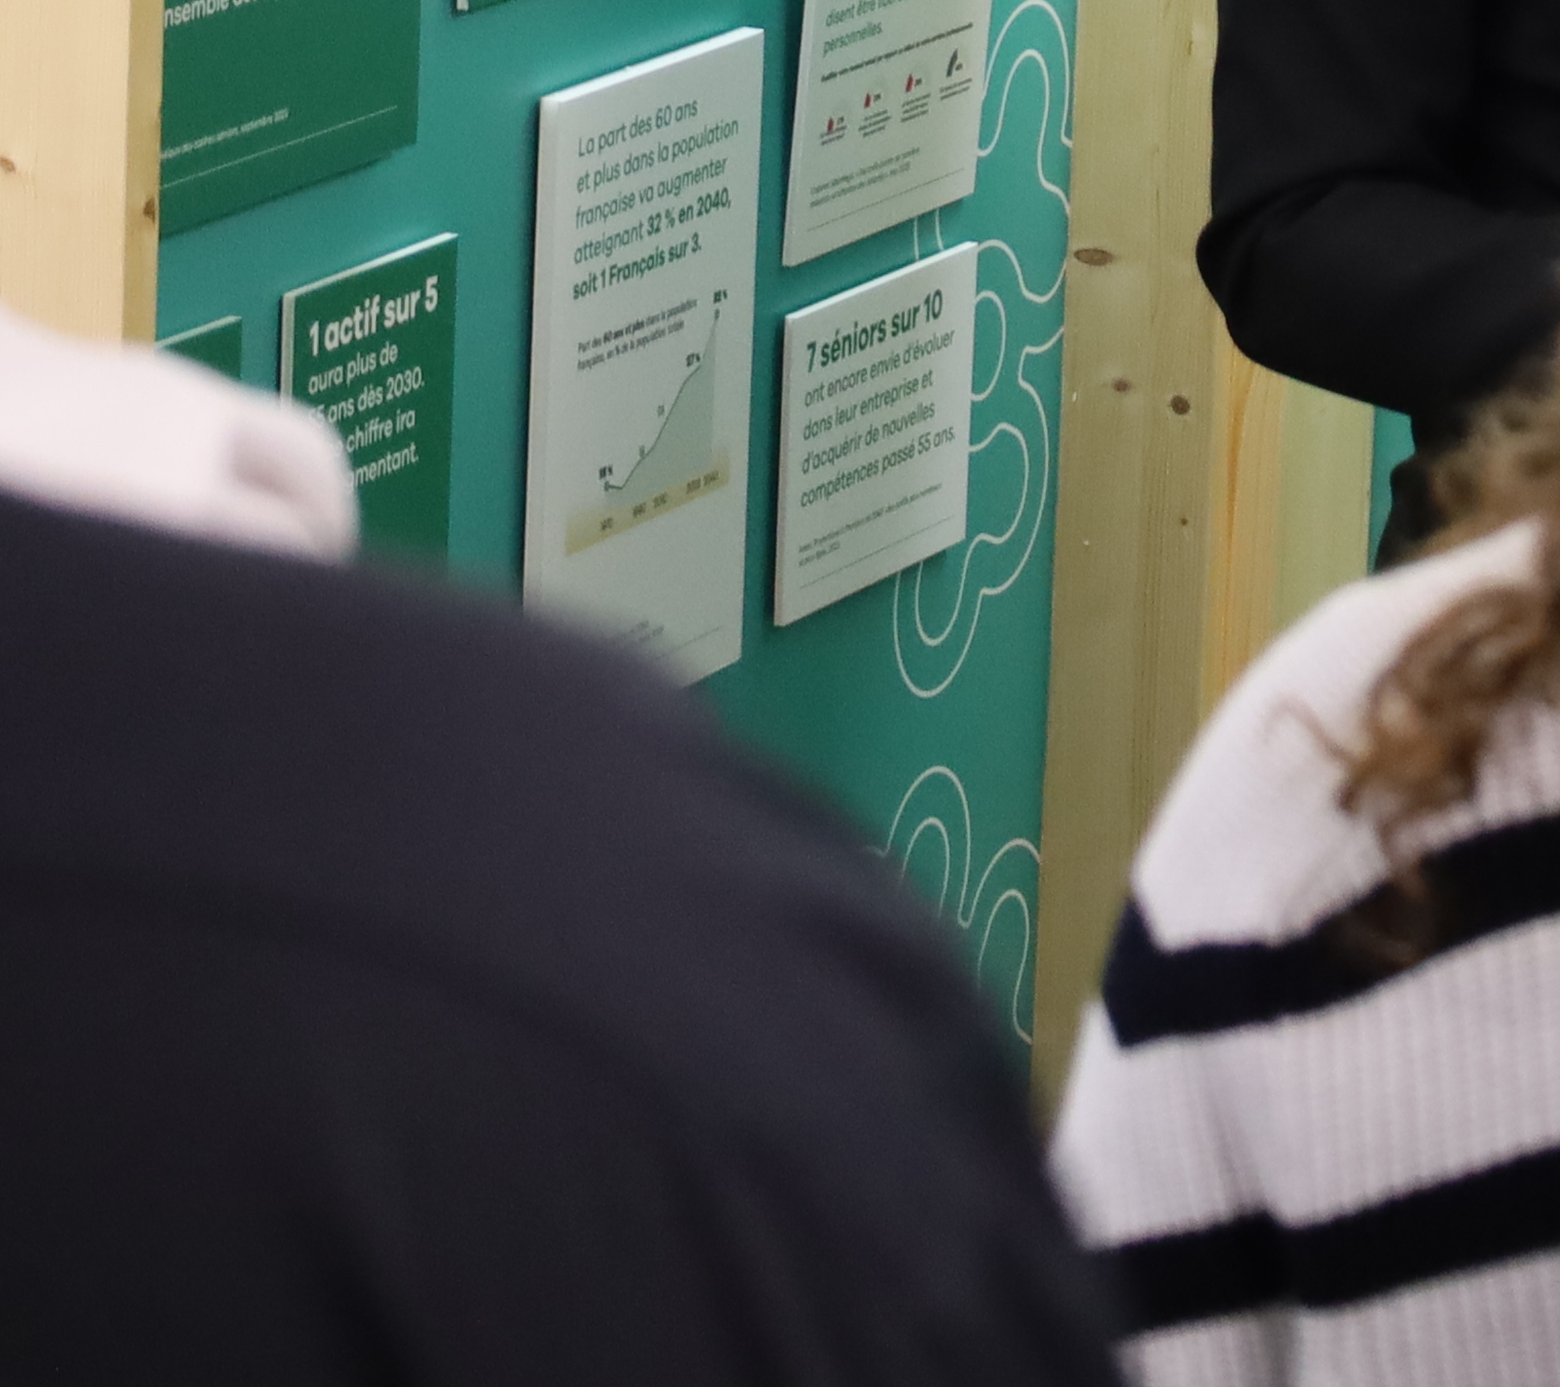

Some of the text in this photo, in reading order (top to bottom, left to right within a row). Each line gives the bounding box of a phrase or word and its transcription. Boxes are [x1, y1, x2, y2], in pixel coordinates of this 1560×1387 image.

[572, 231, 701, 300] soit 1 Français sur 3.
[309, 278, 438, 356] 1 actif sur 5
[806, 290, 943, 373] 7 séniors sur 10
